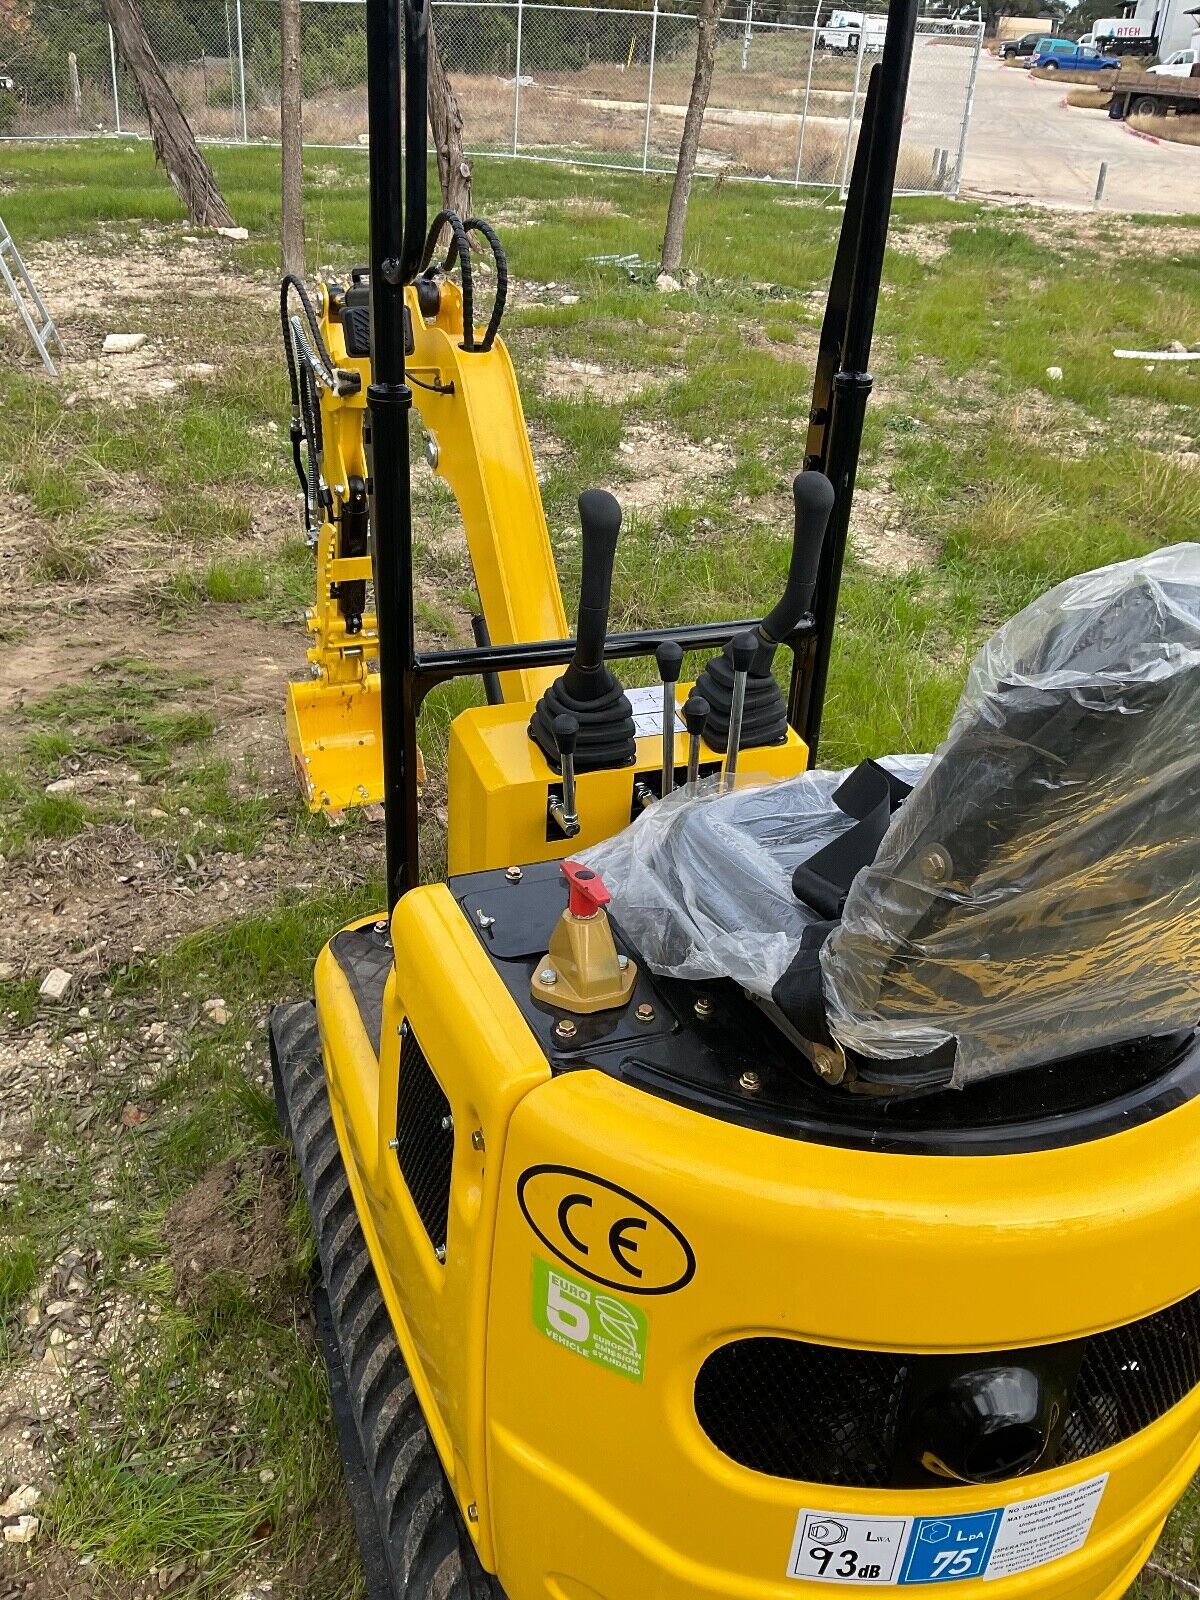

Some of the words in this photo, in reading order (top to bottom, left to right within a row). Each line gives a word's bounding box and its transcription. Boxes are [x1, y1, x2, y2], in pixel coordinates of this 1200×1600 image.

[557, 1193, 648, 1279] CE
[551, 1274, 588, 1301] EURO
[545, 1327, 590, 1358] VEHICLE
[592, 1333, 642, 1360] EUROPEAN
[594, 1342, 639, 1367] EMISSION
[592, 1349, 641, 1375] STANDARD
[1007, 1514, 1023, 1523] MAY
[1024, 1506, 1056, 1519] OPERATE
[1058, 1499, 1073, 1508] THIS
[1073, 1487, 1103, 1502] MACHINE
[1022, 1491, 1076, 1511] UNAUTHORISED
[1078, 1479, 1104, 1493] PERSON
[994, 1538, 1038, 1554] OPERATORS
[930, 1547, 979, 1578] 75
